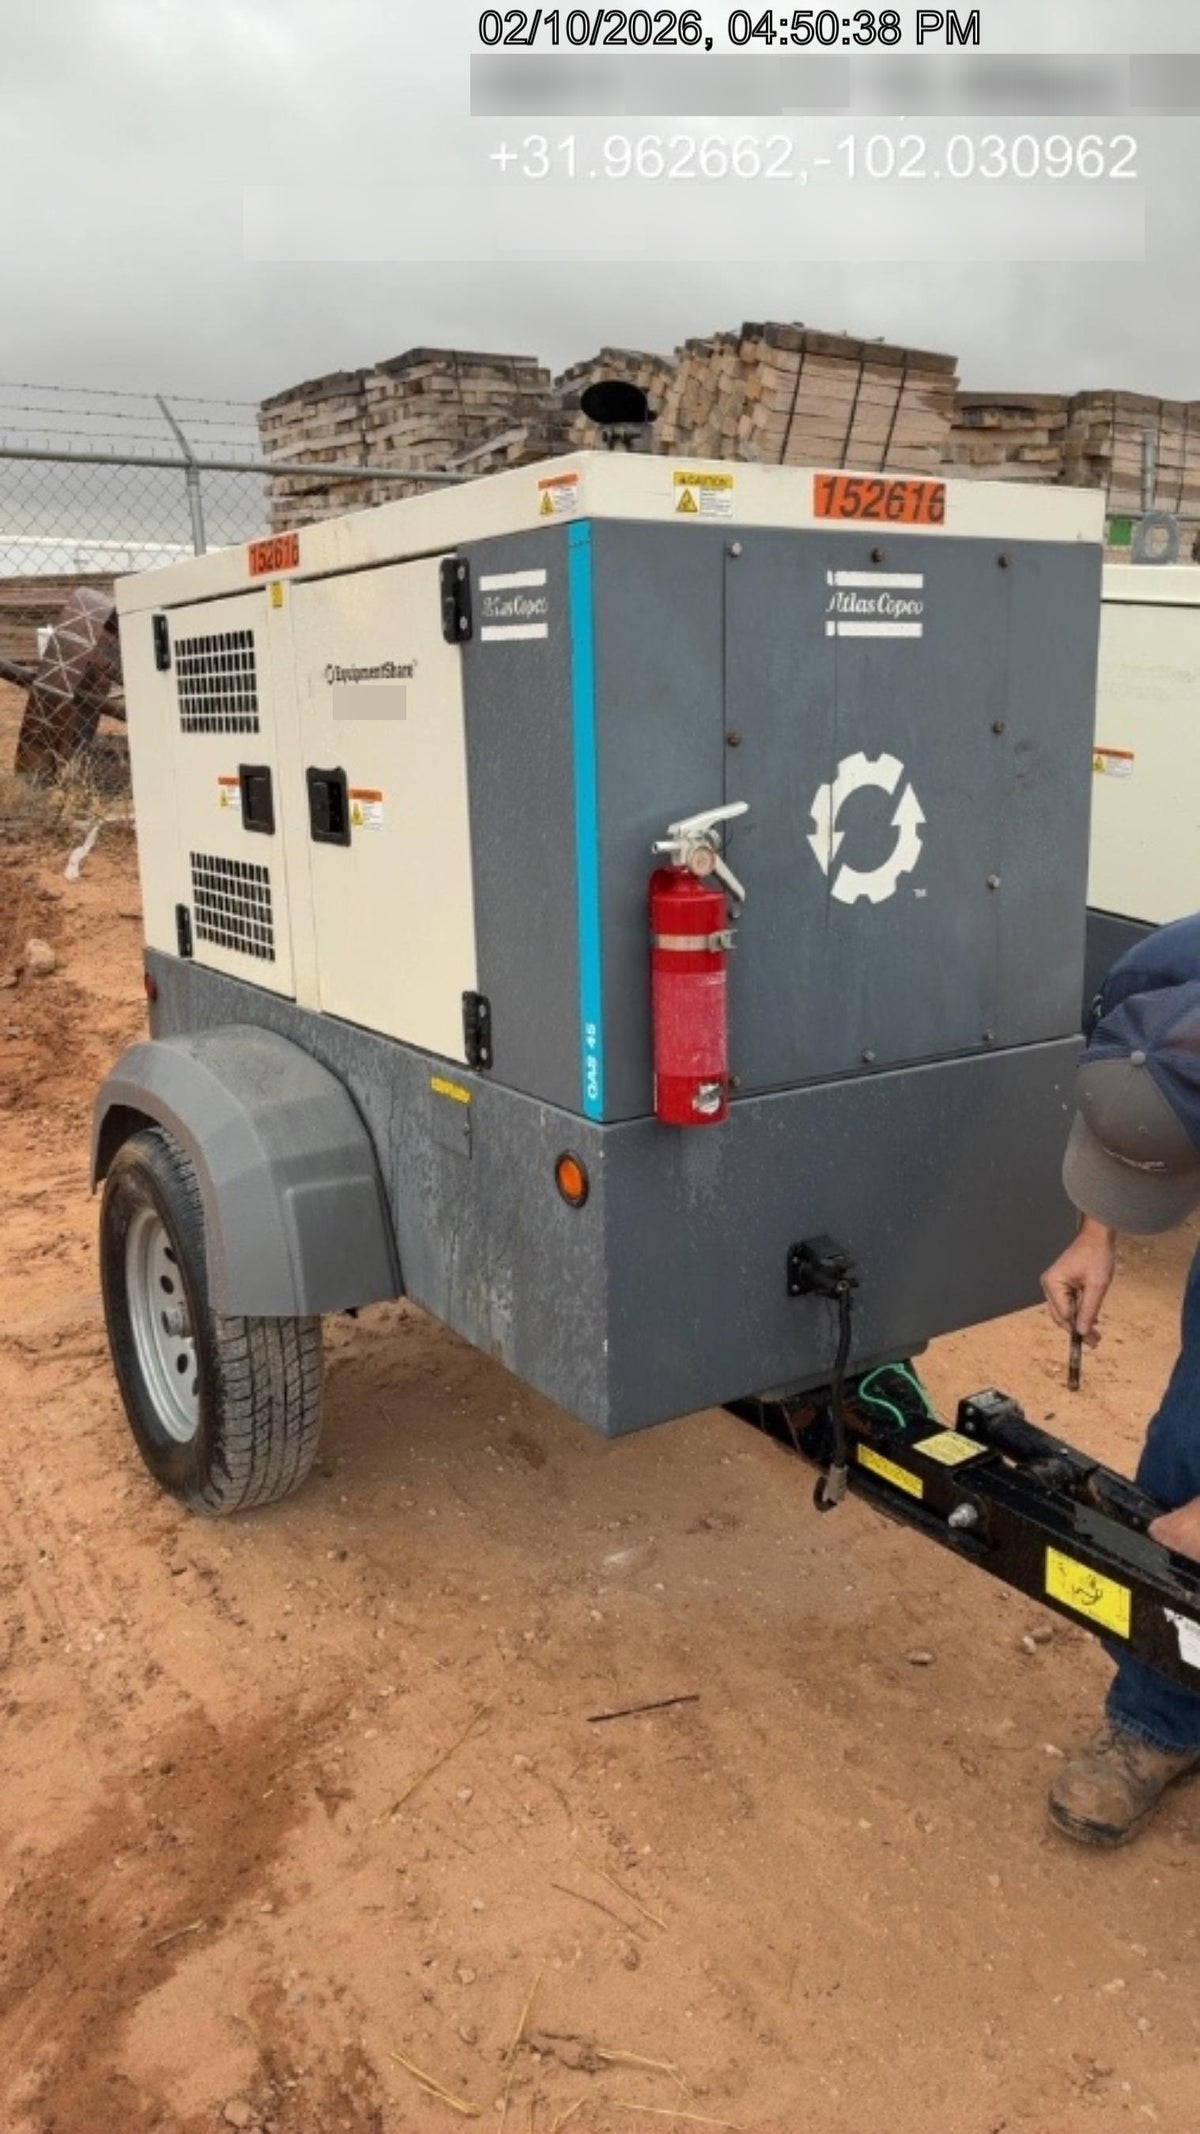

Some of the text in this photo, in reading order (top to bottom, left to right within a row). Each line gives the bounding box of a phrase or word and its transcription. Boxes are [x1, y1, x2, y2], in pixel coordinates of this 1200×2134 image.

[822, 475, 945, 522] 152616
[249, 533, 299, 576] 152616
[825, 592, 924, 619] Atlas Copco
[336, 661, 413, 685] EquipmentShare
